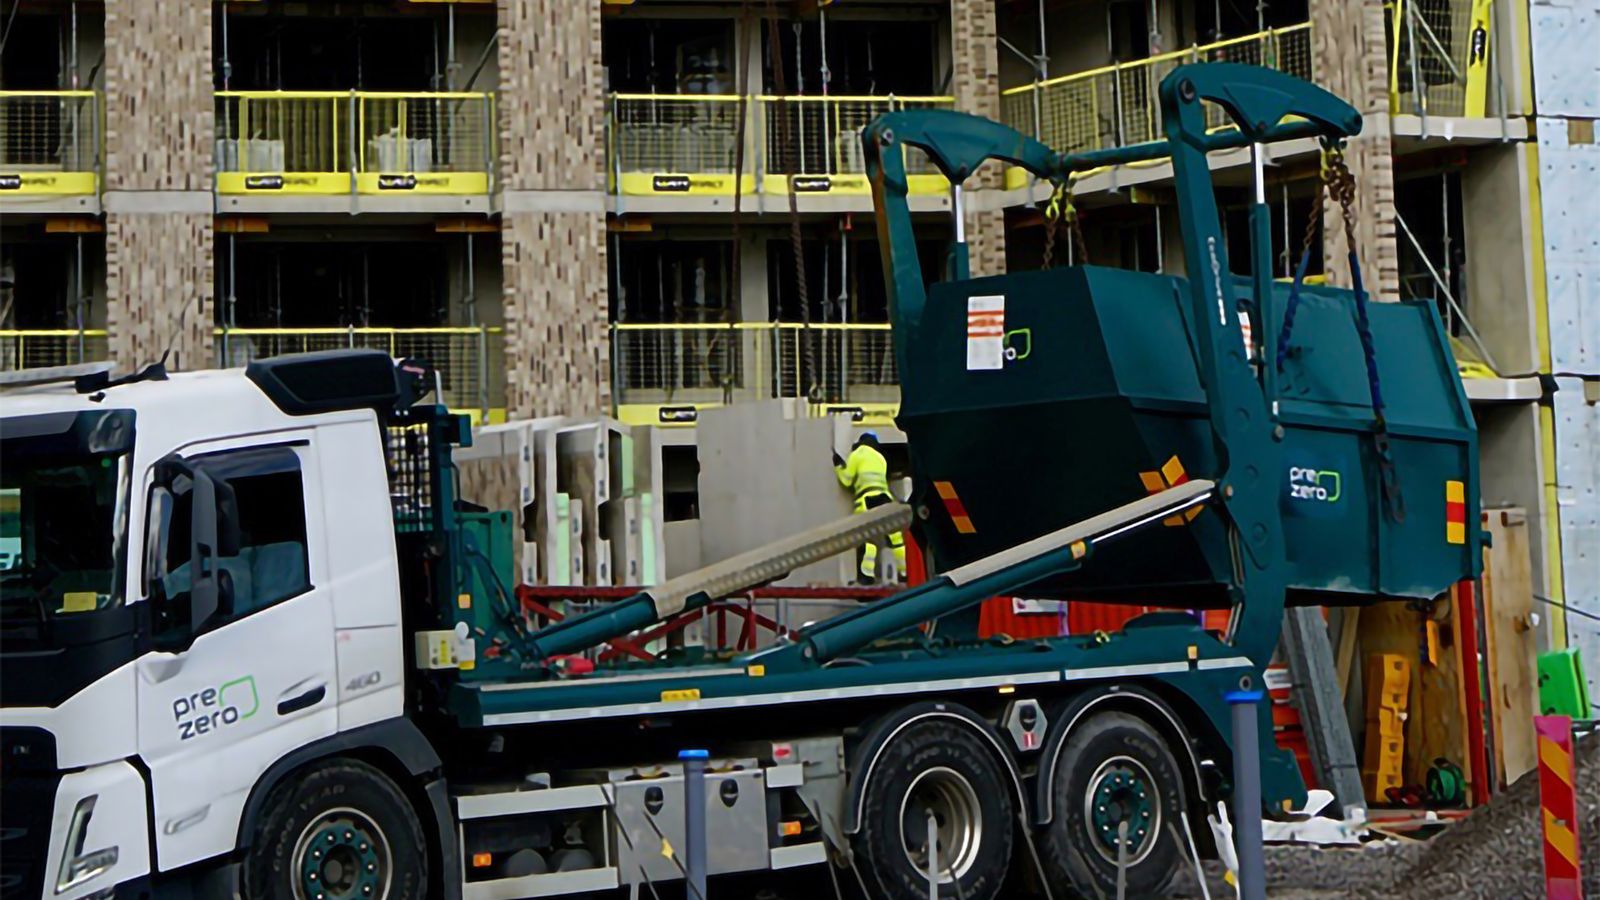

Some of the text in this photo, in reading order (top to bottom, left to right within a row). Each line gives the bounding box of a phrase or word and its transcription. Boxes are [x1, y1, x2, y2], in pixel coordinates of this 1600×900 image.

[1290, 467, 1316, 482] pre
[1291, 484, 1327, 501] zero
[172, 687, 217, 722] pre
[178, 705, 239, 741] zero
